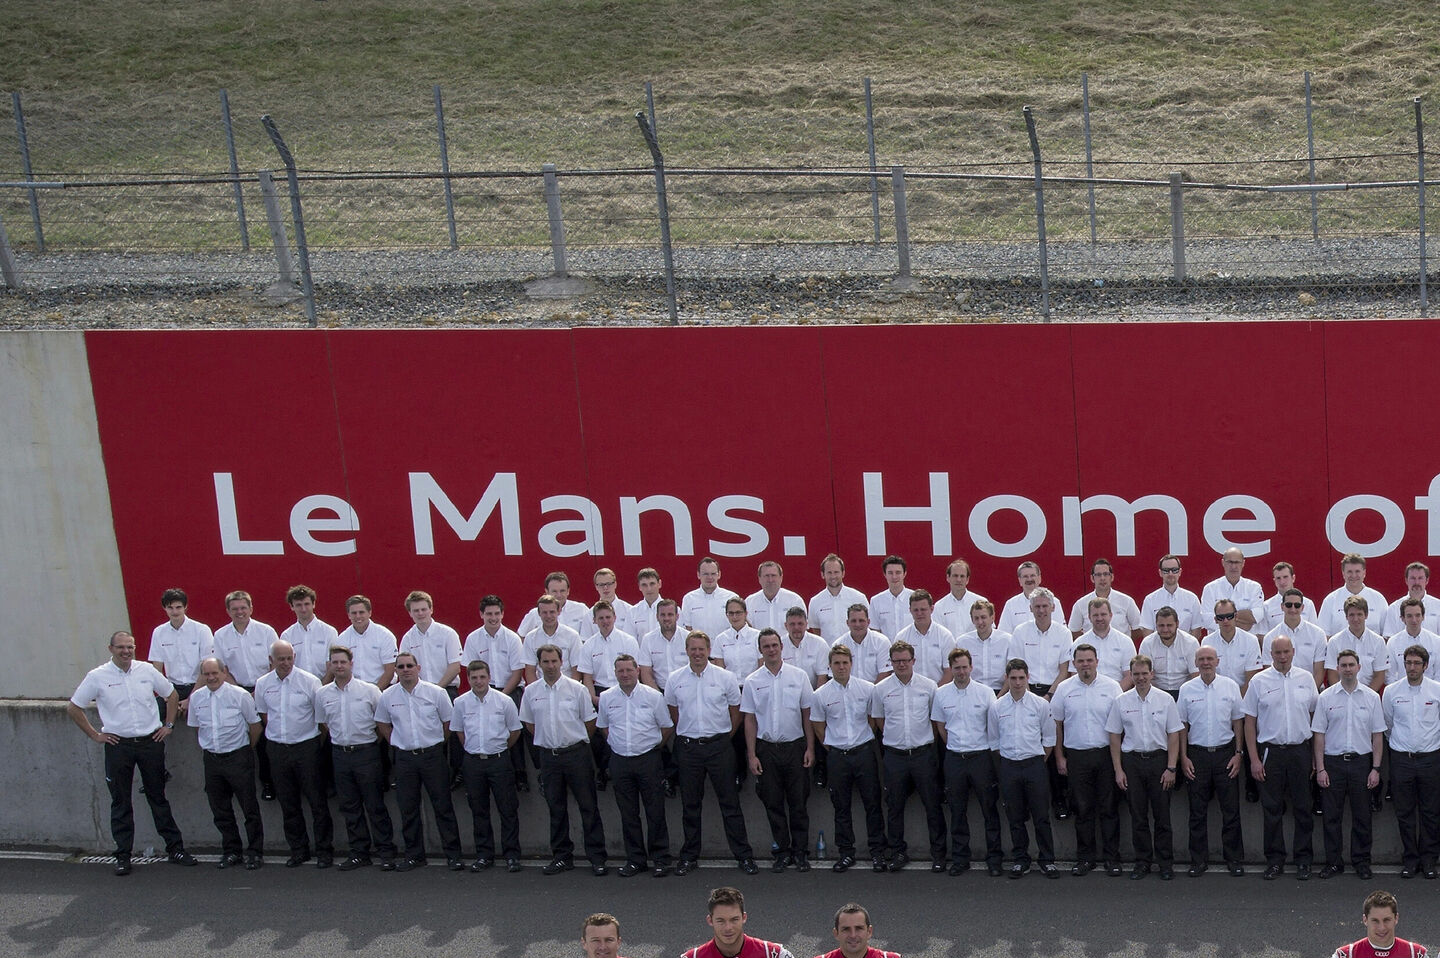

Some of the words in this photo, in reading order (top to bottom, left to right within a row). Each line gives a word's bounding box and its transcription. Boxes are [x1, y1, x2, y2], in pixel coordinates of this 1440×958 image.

[213, 472, 361, 557] Le
[409, 472, 807, 557] Mans.
[863, 472, 1277, 558] Home
